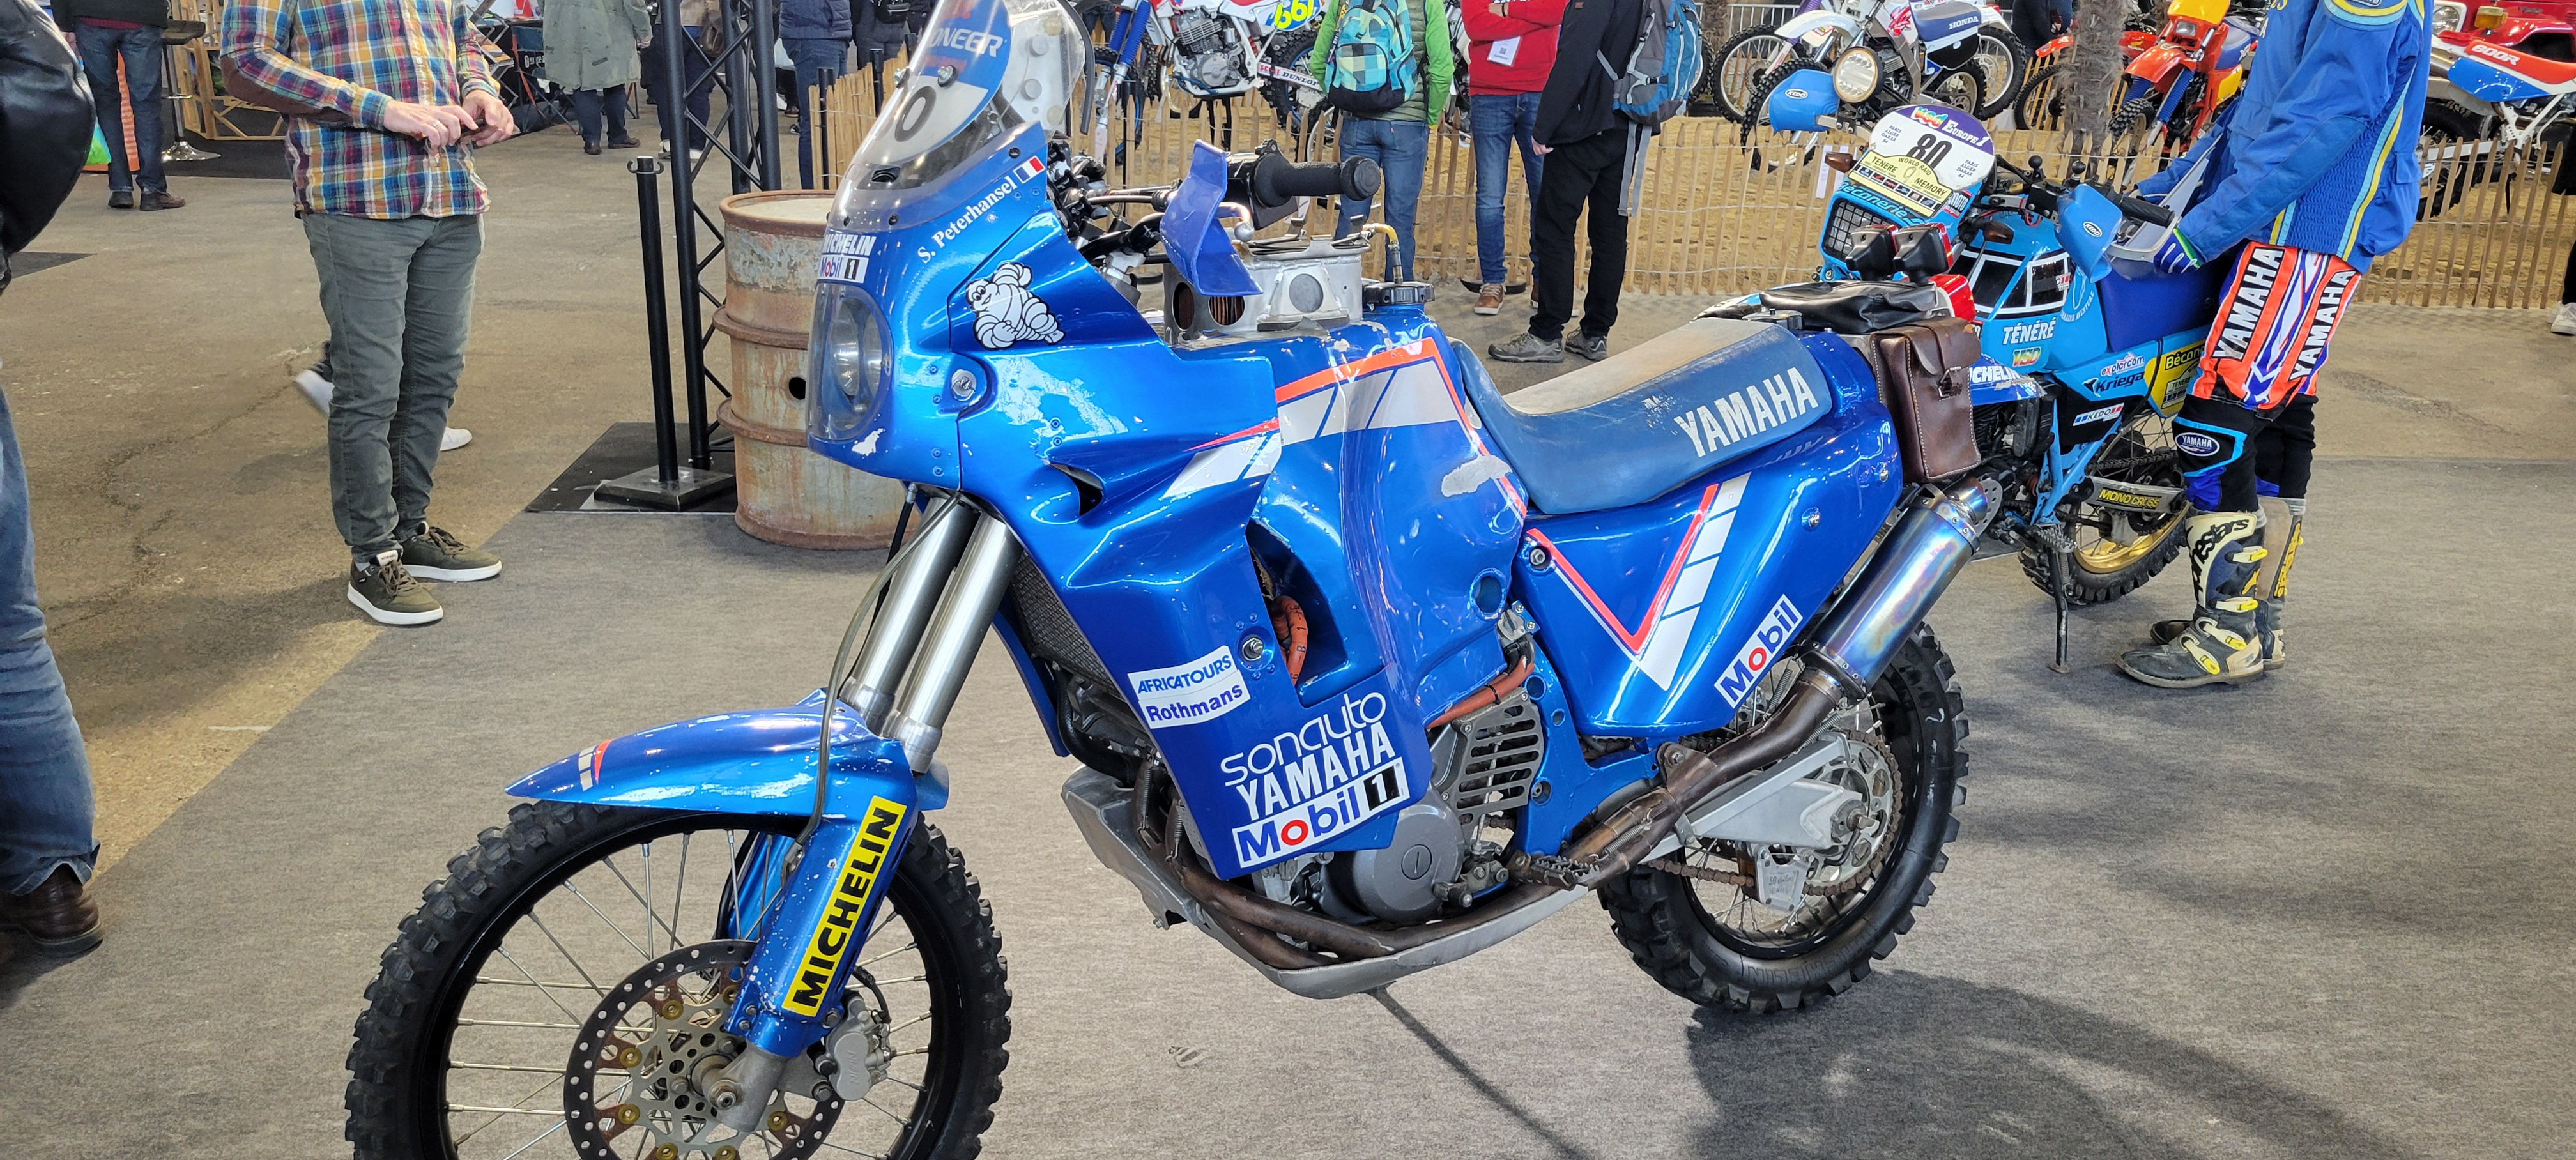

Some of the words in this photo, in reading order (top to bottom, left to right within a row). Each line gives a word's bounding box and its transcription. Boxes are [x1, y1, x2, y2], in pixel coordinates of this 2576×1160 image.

[1949, 16, 1979, 30] HONDA
[2471, 44, 2520, 66] 600R
[1885, 129, 1899, 137] ALGER
[1871, 156, 1899, 173] TENERE
[1906, 133, 1952, 169] 80
[1898, 157, 1919, 167] WORLD
[1920, 164, 1932, 176] RAID
[1960, 164, 1976, 172] ALGER
[1914, 178, 1947, 196] MEMORY
[917, 246, 936, 264] S.
[931, 176, 1018, 248] Peterhansel
[2085, 223, 2100, 236] KEDO
[2212, 248, 2285, 360] YAMAHA
[2003, 317, 2057, 344] TÉNÉRÉ
[2289, 270, 2357, 381] YAMAHA
[2096, 372, 2145, 392] Kriega
[1673, 367, 1819, 458] YAMAHA
[2088, 409, 2112, 420] KEDO
[2182, 435, 2212, 448] YAMAHA
[2099, 489, 2131, 504] MONO
[2131, 496, 2160, 508] CROSS
[1720, 600, 1798, 703] Mobil
[1137, 655, 1232, 694] AFRICATOURS
[1147, 682, 1243, 722] Rothmans
[1220, 692, 1386, 786] sonauto
[1236, 721, 1397, 821] YAMAHA
[1237, 788, 1361, 862] Mobil
[793, 807, 898, 1007] MICHELIN
